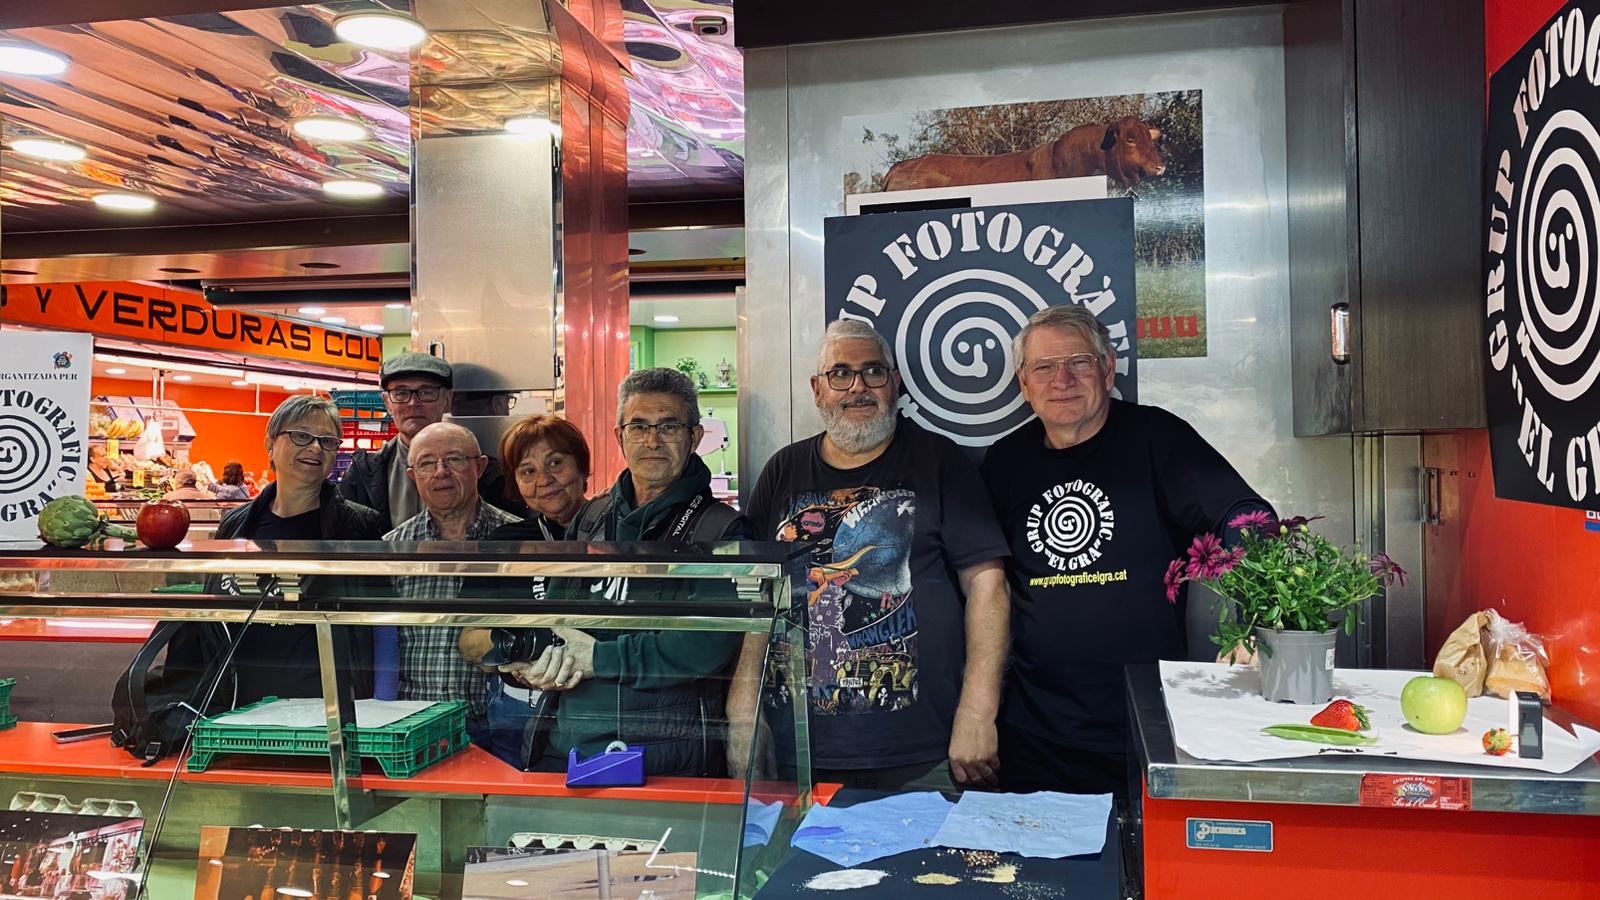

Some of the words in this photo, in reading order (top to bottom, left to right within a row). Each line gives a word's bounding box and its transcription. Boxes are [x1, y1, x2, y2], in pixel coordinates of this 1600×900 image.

[1486, 148, 1514, 372] GRUP
[34, 286, 53, 313] Y
[74, 284, 311, 352] VERDURAS
[59, 373, 78, 381] PER
[672, 508, 693, 537] DIGITAL
[1026, 503, 1044, 553] GRUP
[1042, 479, 1115, 541] FOTOGRÀFIC
[847, 602, 918, 649] WRANGLER
